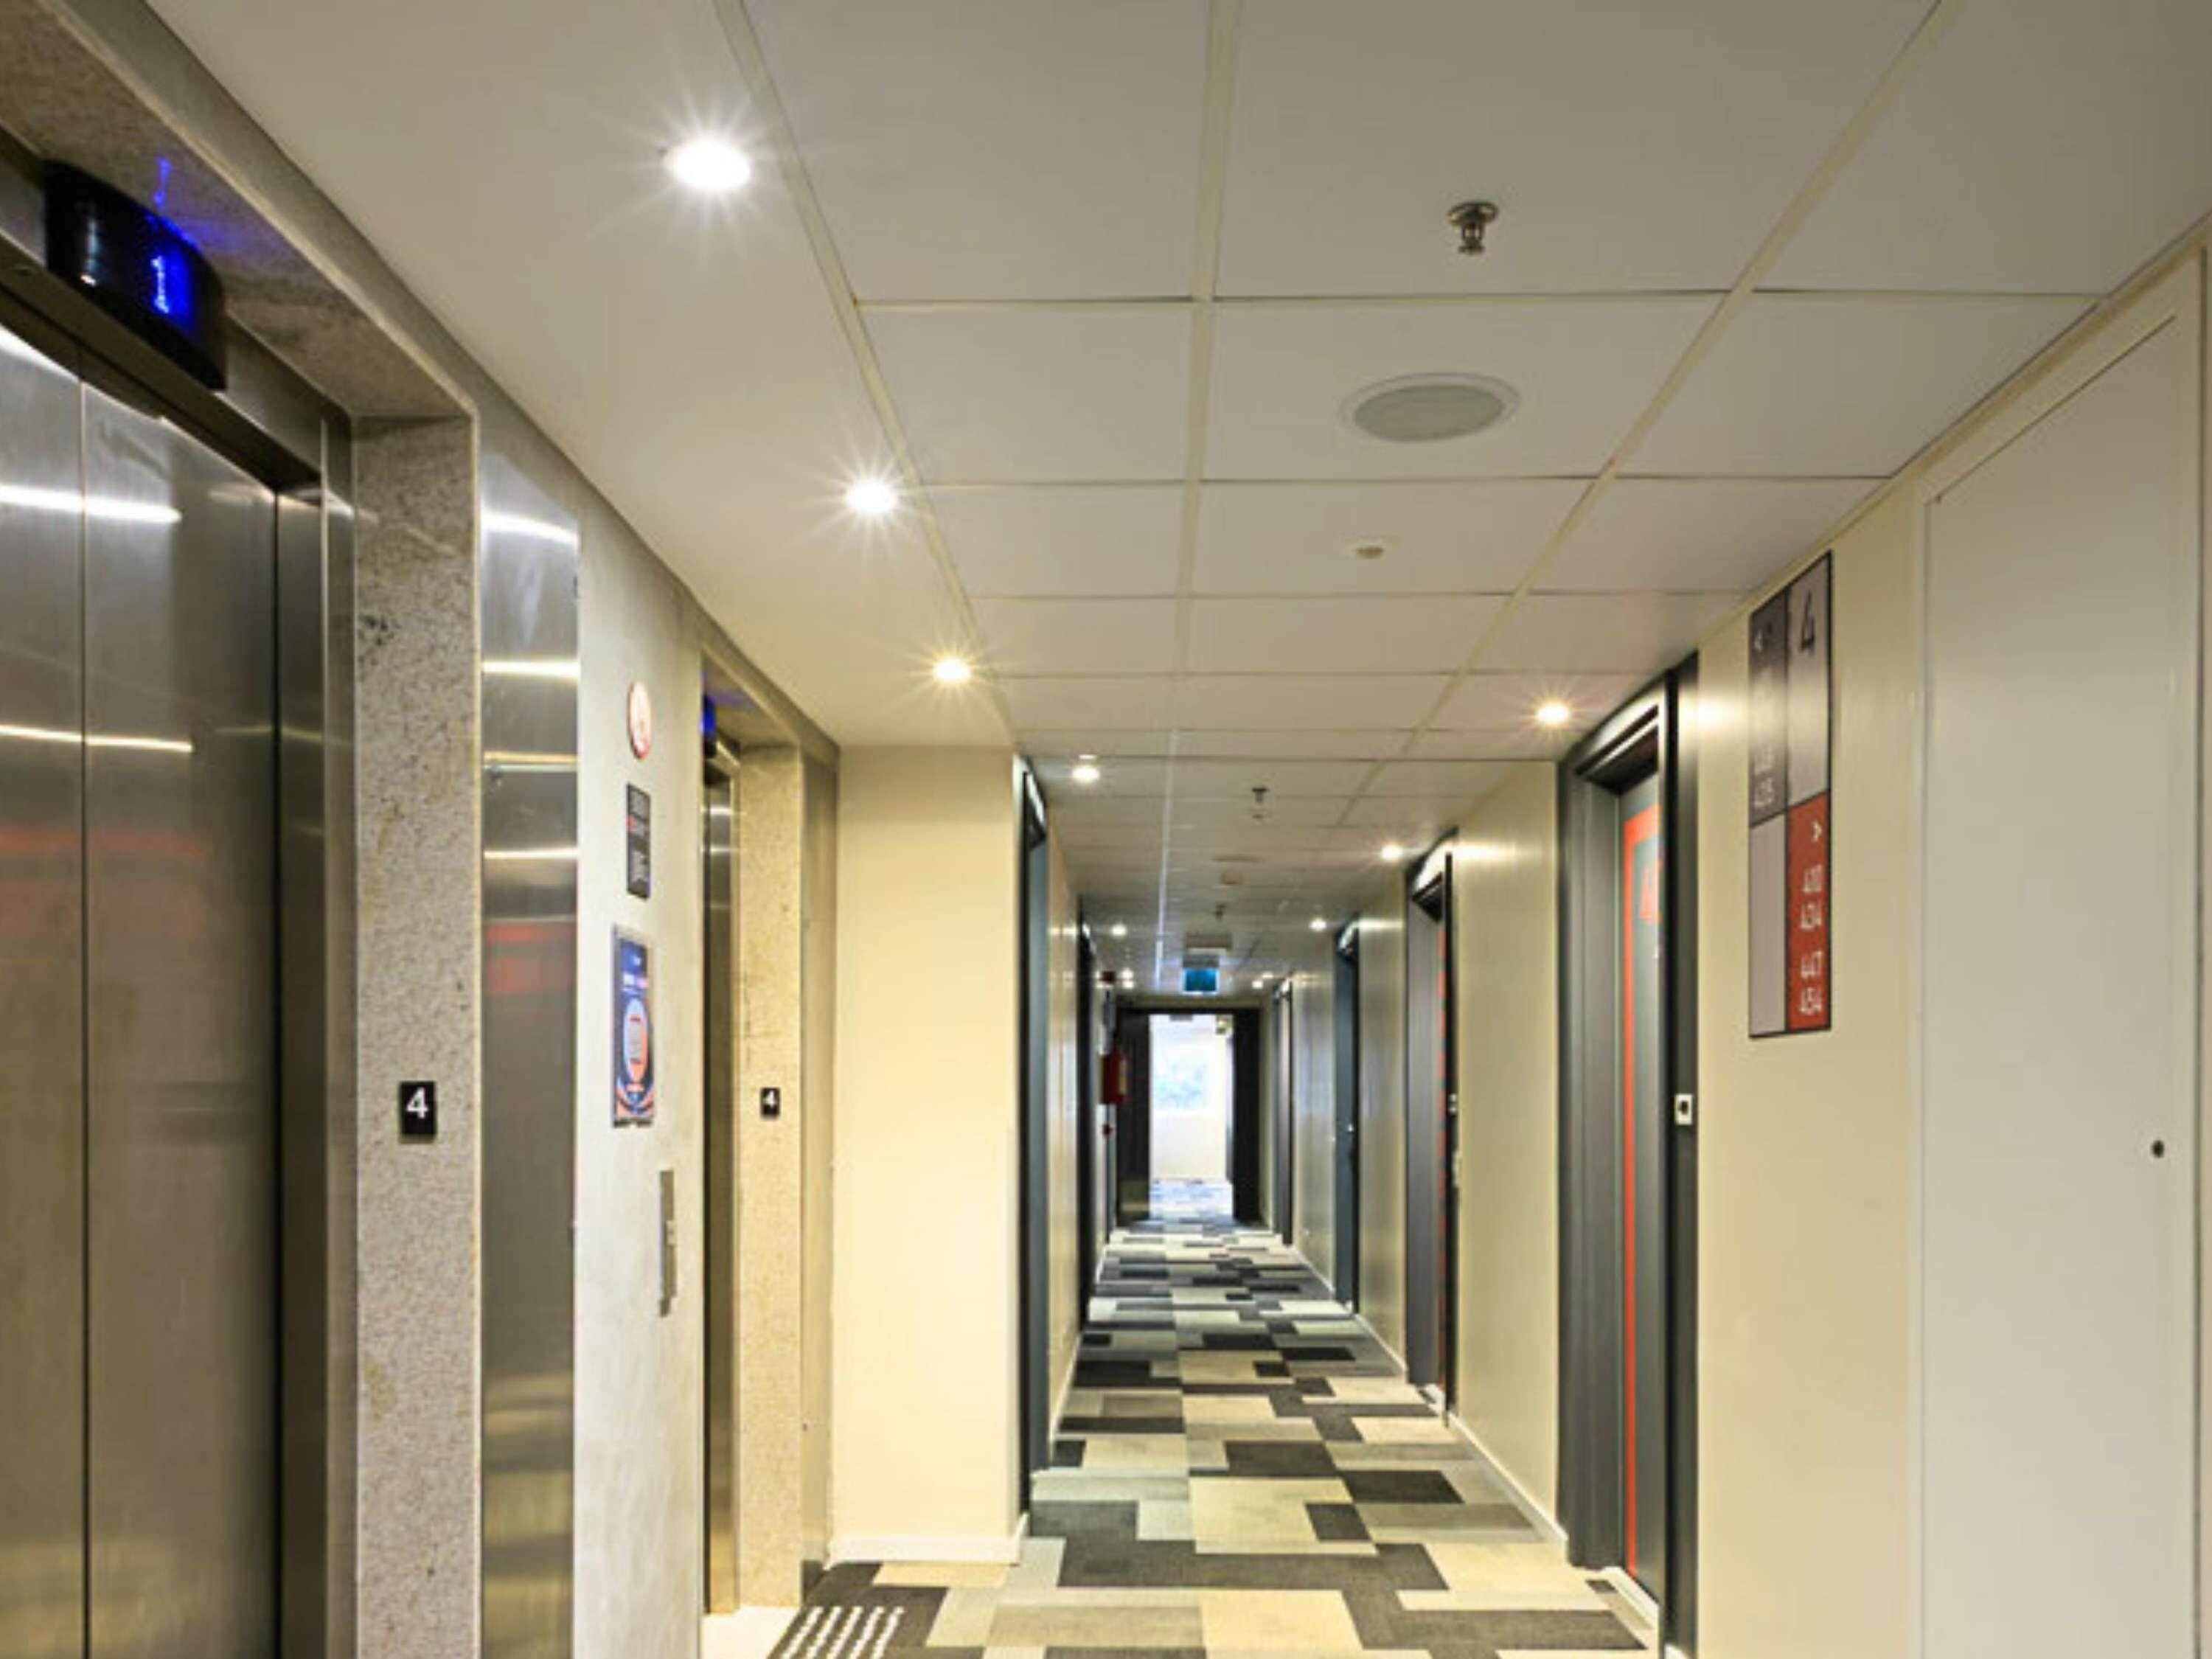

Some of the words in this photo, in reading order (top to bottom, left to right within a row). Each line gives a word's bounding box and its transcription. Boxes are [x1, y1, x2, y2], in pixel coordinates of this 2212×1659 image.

[150, 255, 170, 313] 1
[1800, 591, 1815, 655] 4
[407, 1087, 428, 1119] 4
[762, 1091, 777, 1107] 4
